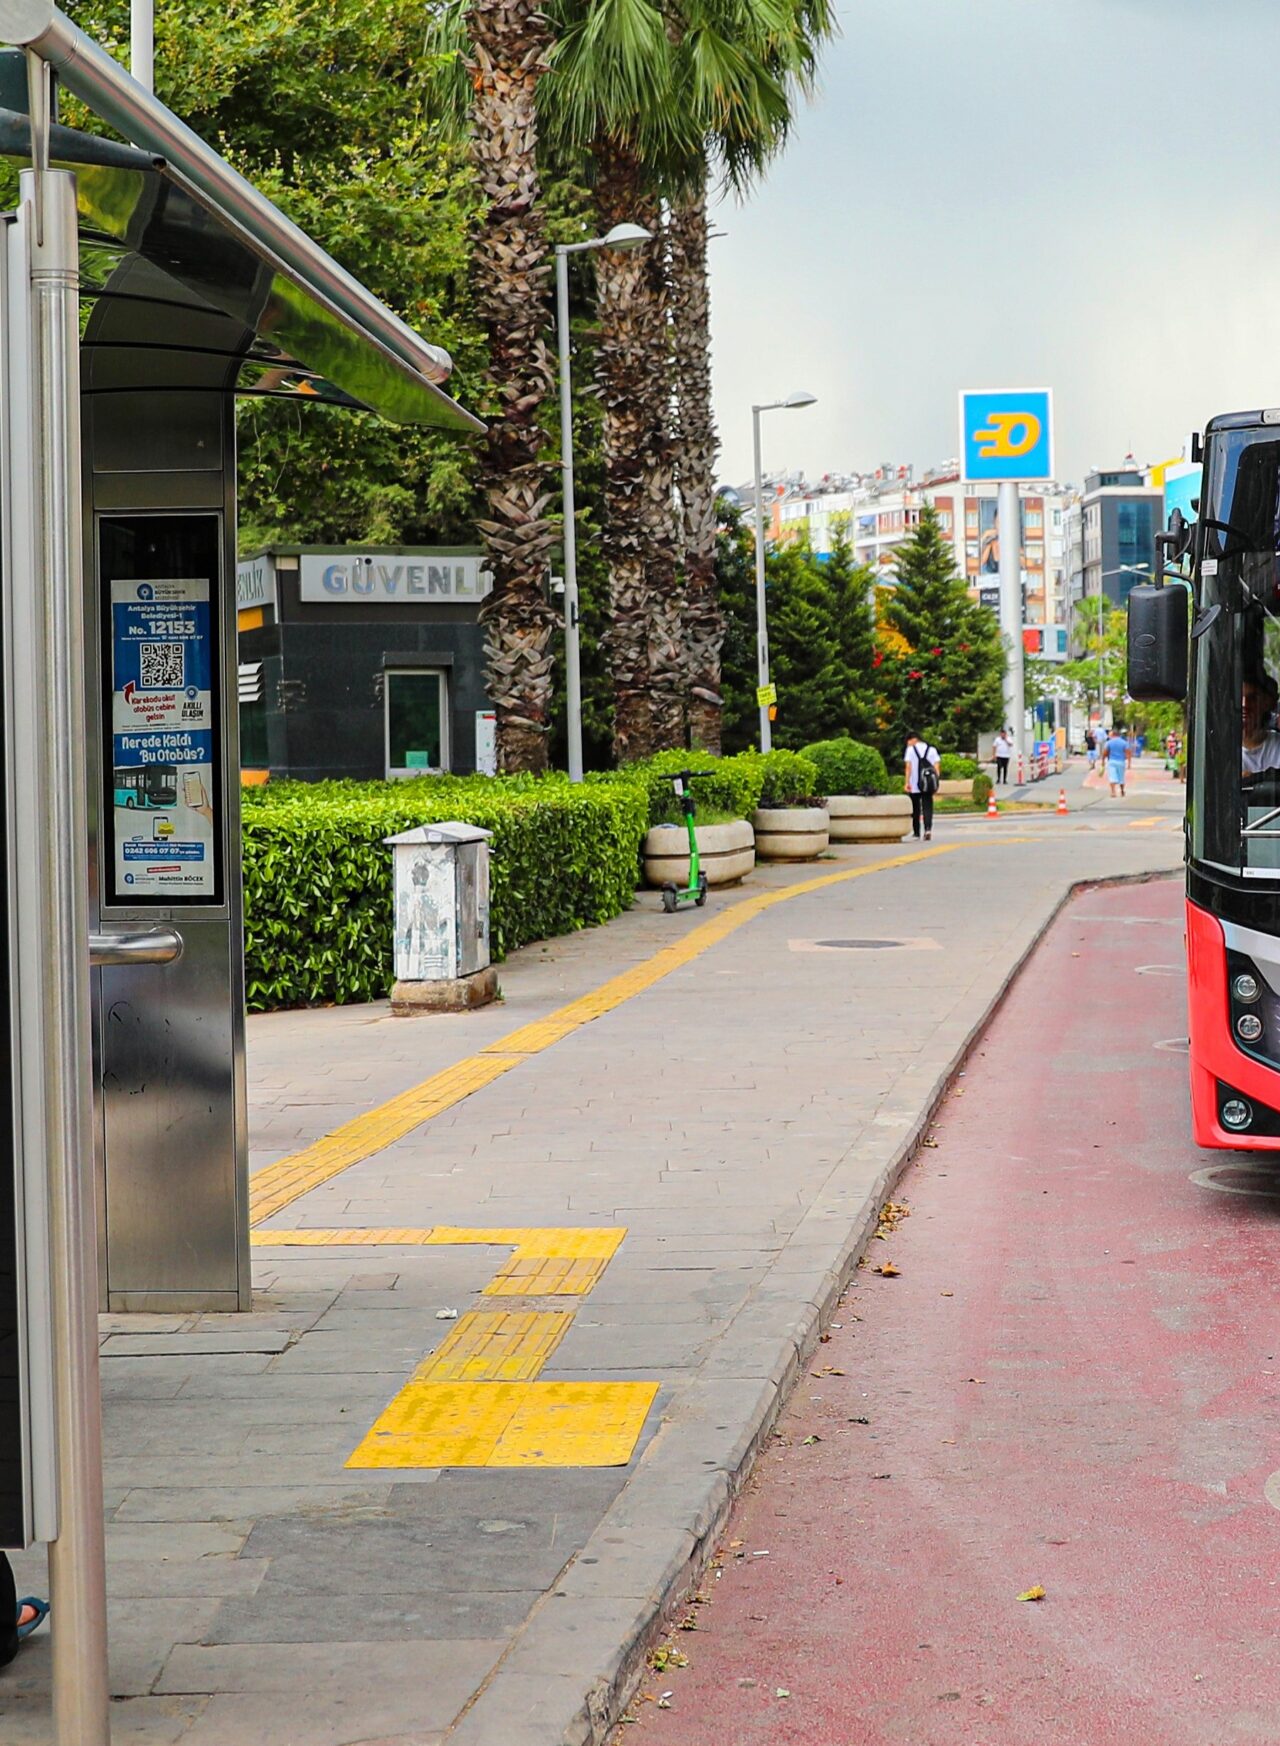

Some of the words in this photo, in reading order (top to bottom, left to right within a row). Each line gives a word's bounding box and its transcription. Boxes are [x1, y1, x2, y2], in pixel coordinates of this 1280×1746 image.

[129, 626, 147, 635] No.
[149, 621, 195, 634] 12153
[122, 735, 161, 750] Nerede
[162, 734, 192, 748] Kaldı
[139, 750, 156, 762] Bu
[157, 748, 204, 762] Otobüs?
